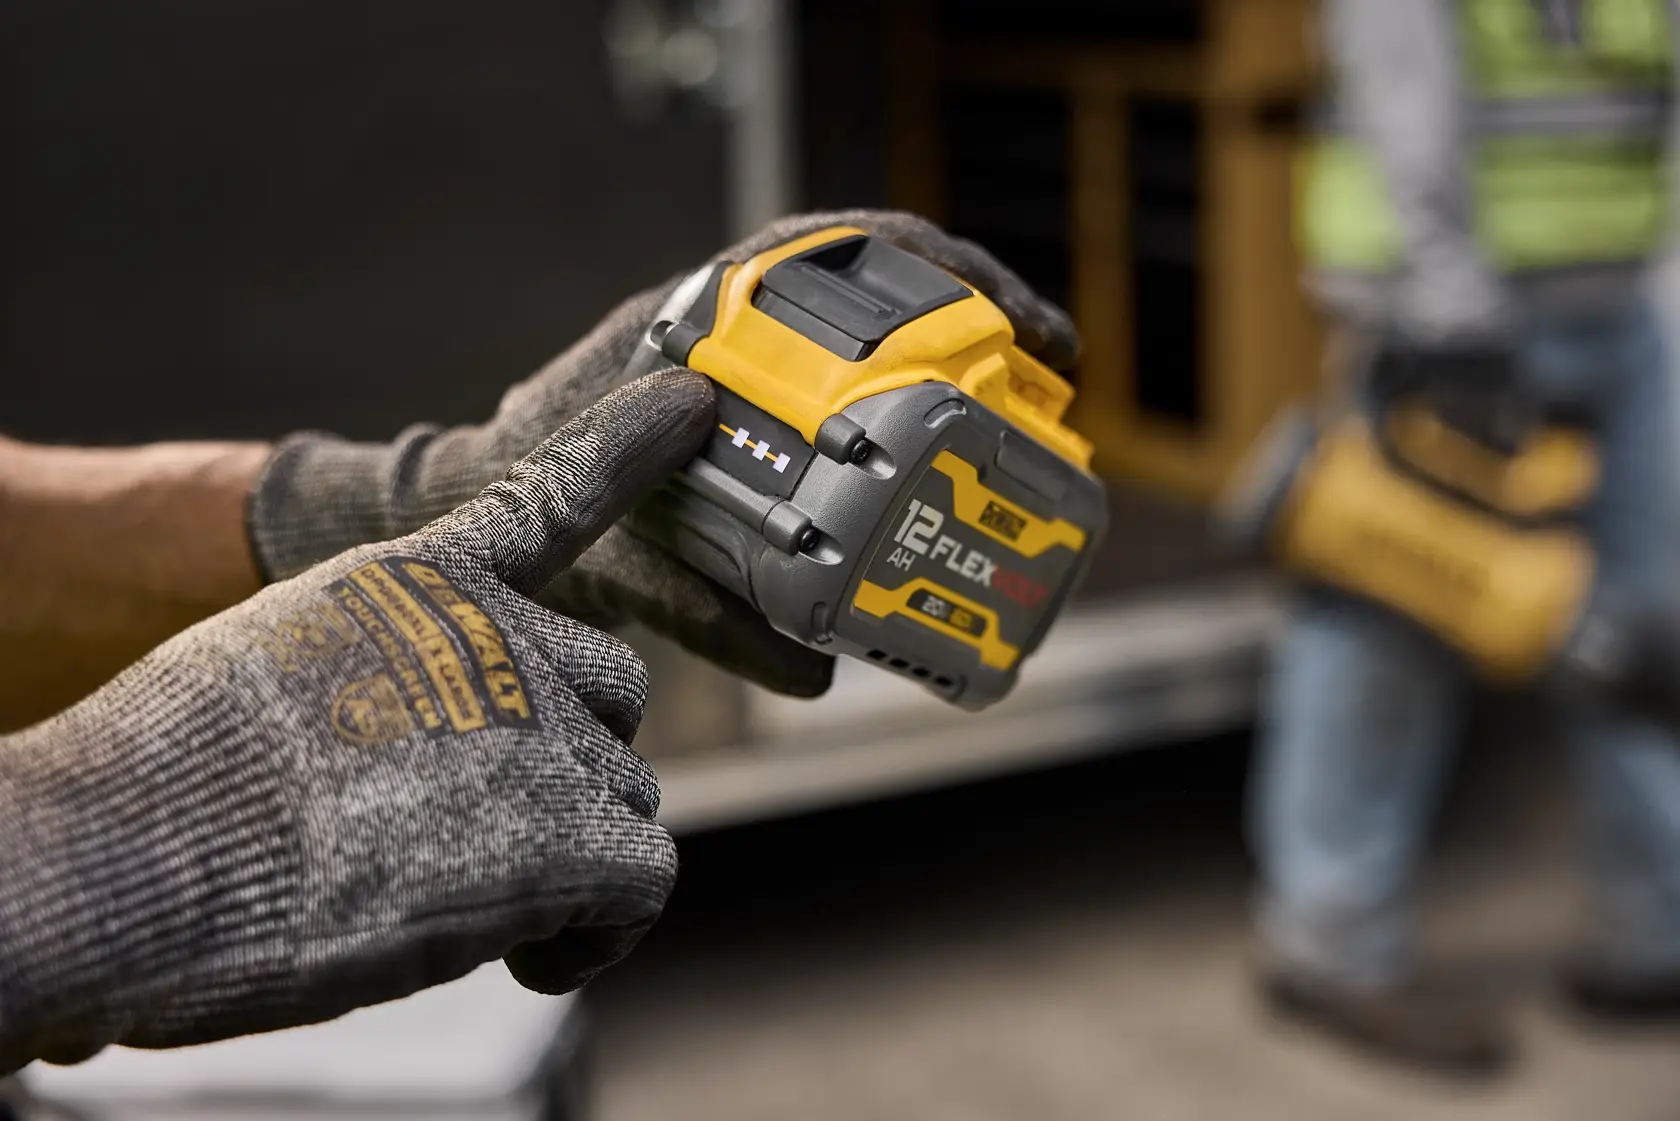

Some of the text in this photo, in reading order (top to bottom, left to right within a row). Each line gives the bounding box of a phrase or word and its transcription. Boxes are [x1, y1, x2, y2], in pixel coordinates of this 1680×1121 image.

[886, 547, 916, 572] AH
[894, 498, 945, 556] 12
[340, 585, 442, 729] TOUCHSCREEN
[402, 562, 532, 720] DEWALT
